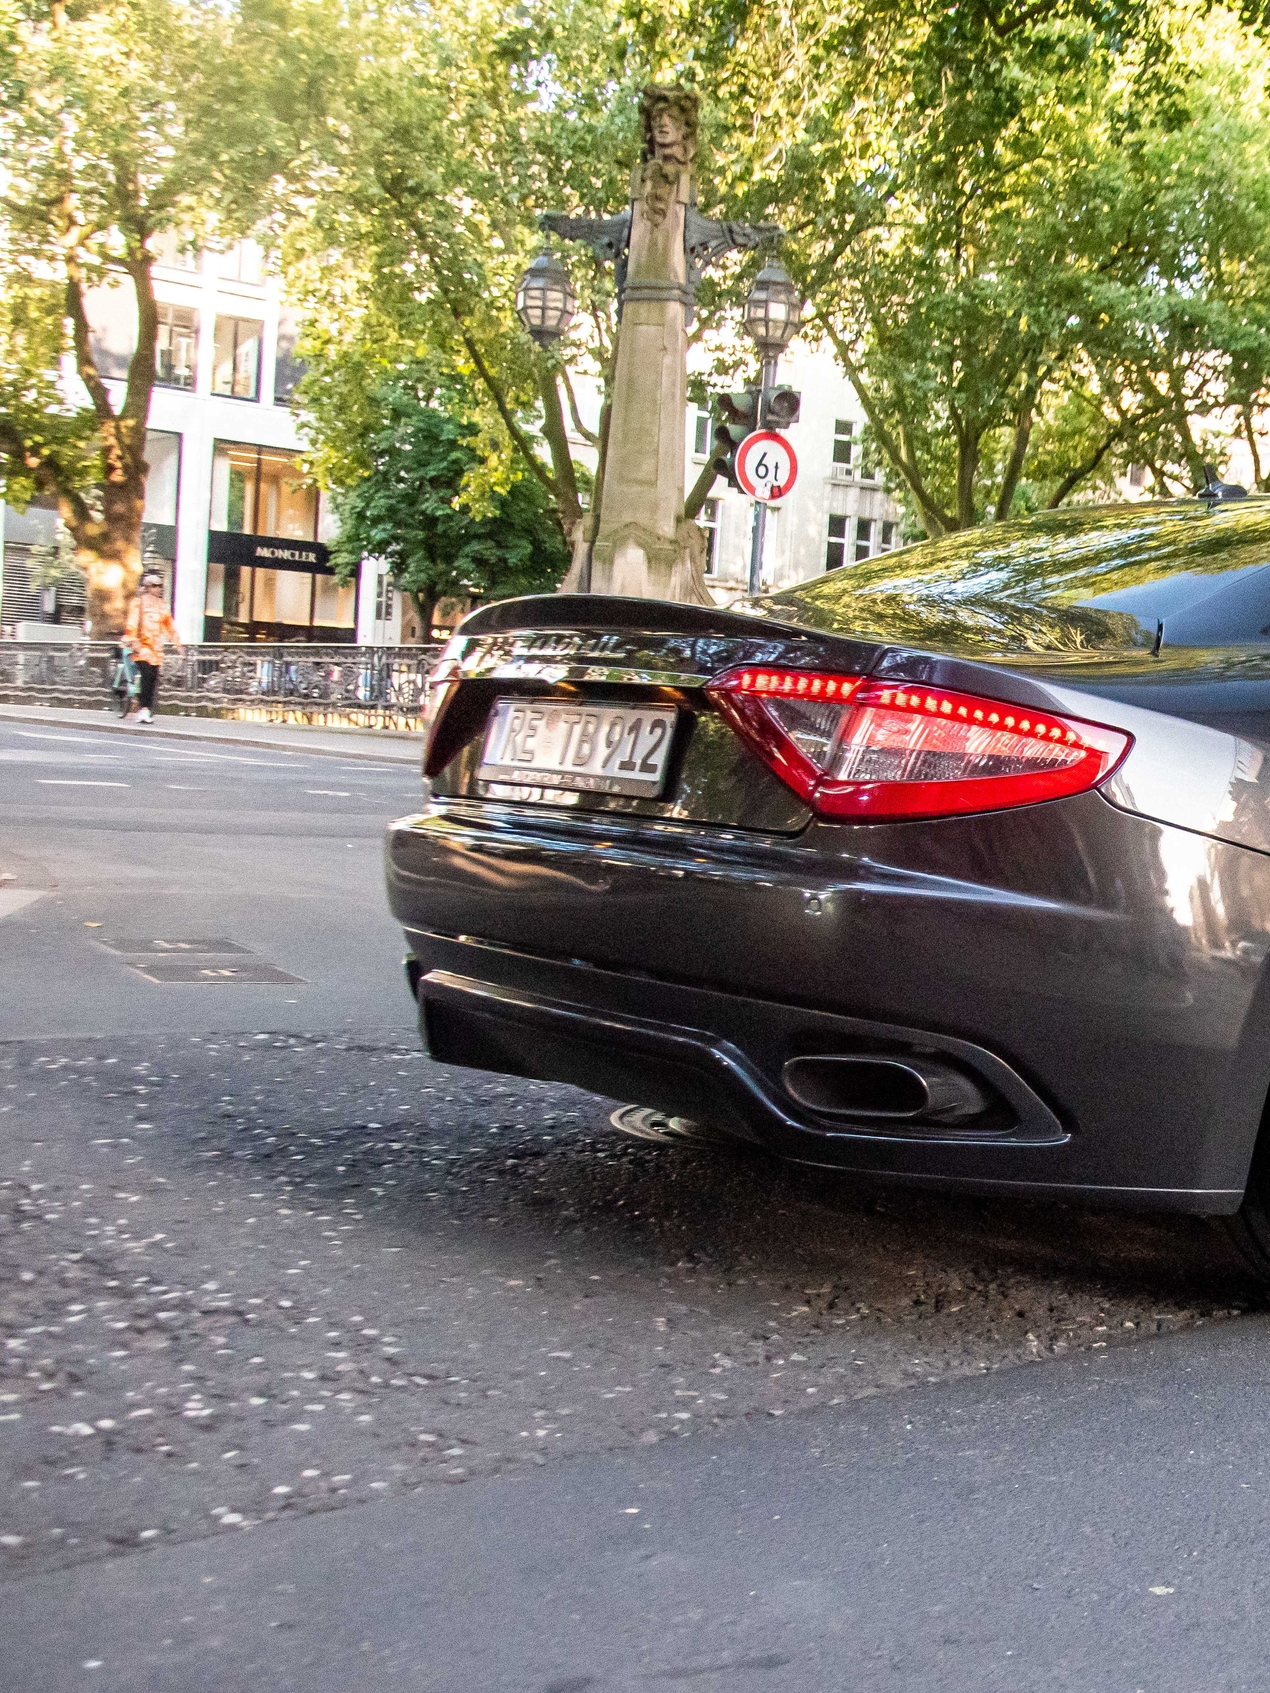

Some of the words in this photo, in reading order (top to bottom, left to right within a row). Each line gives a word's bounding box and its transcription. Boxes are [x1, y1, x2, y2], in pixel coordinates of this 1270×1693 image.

[255, 546, 317, 563] MONCLER
[501, 709, 544, 763] RE
[601, 715, 667, 775] 912
